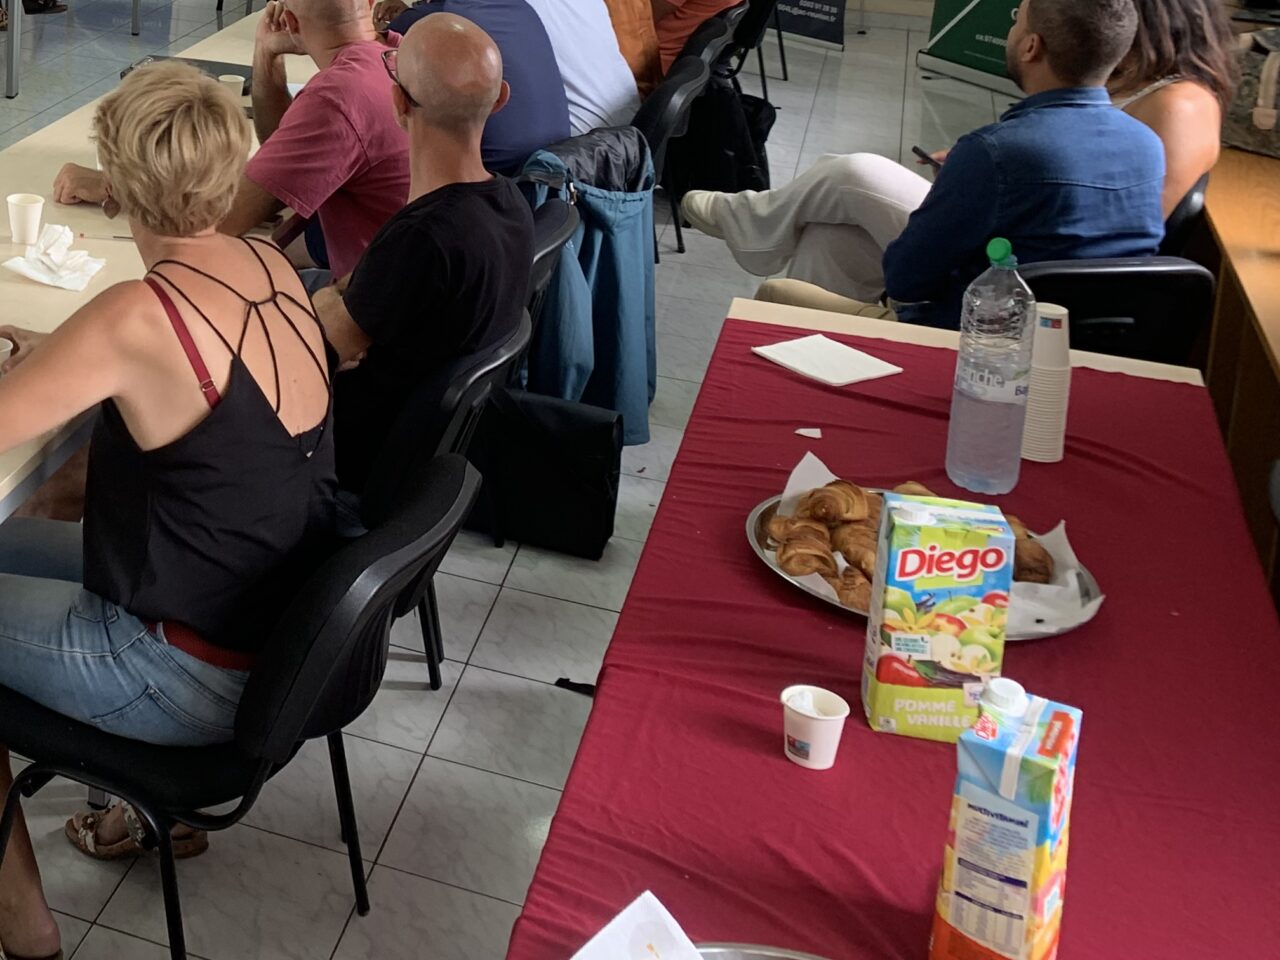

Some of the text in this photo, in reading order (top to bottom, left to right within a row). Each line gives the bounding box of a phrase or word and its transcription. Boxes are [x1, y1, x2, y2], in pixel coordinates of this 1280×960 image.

[896, 544, 1005, 580] Diego
[894, 700, 956, 713] POMME
[907, 714, 971, 728] VANILLE
